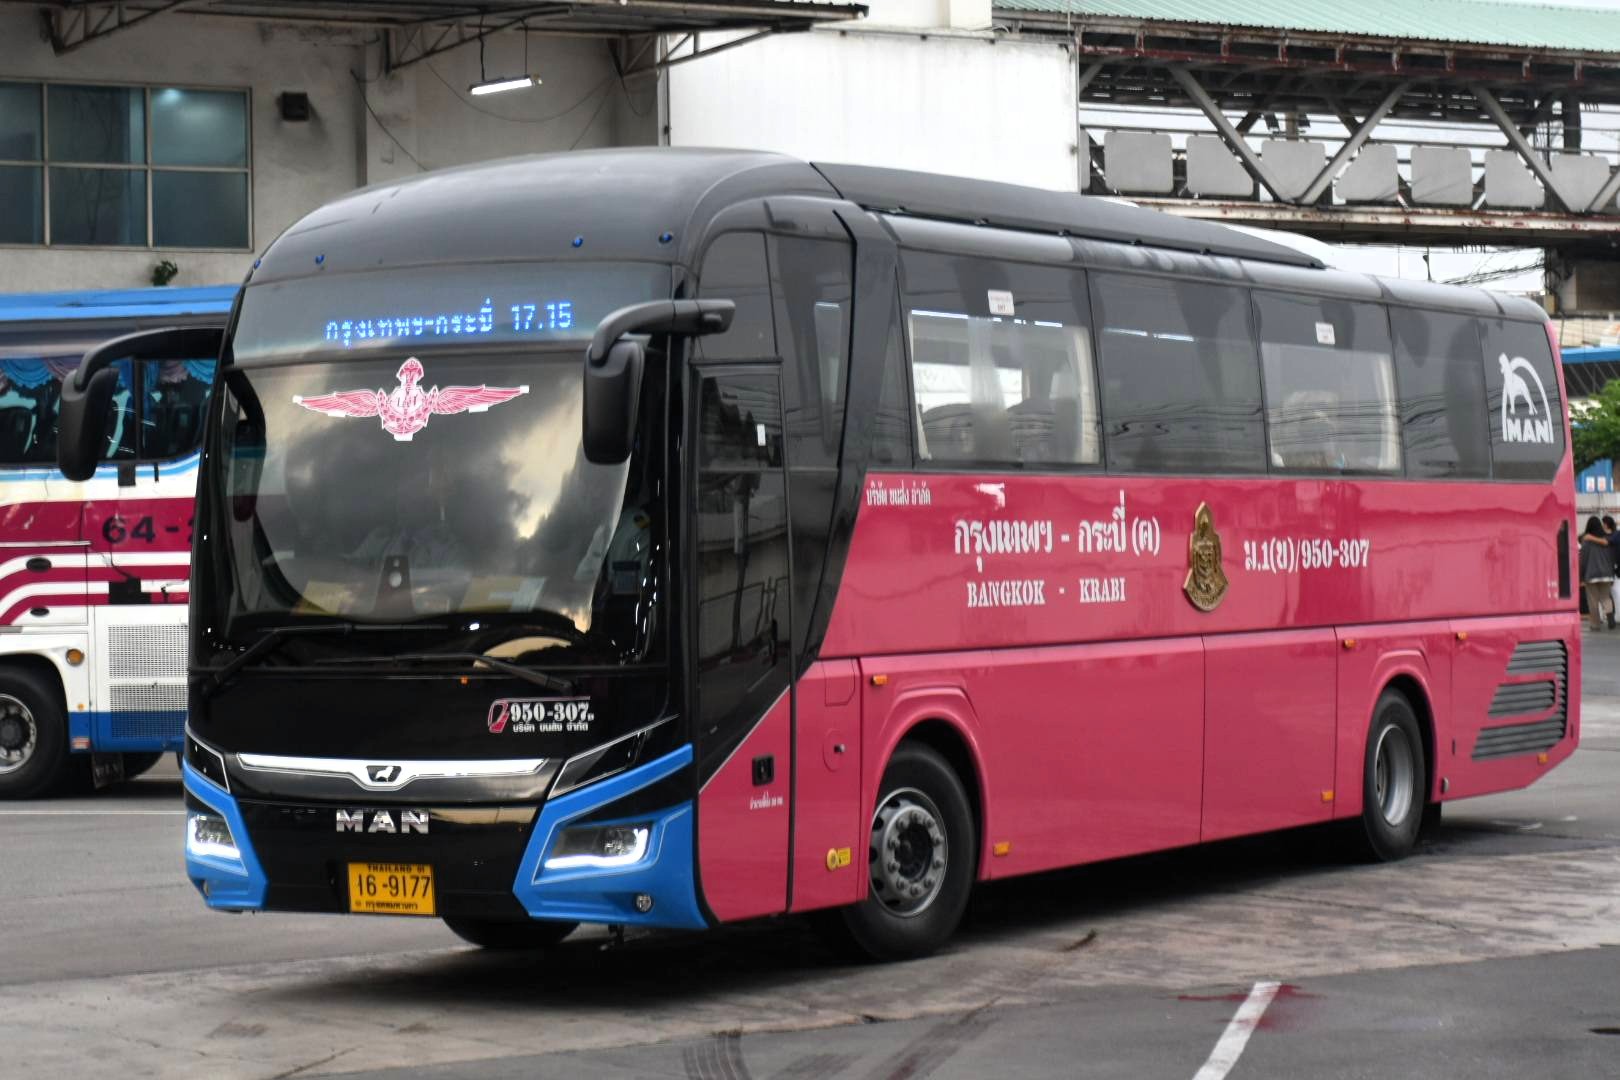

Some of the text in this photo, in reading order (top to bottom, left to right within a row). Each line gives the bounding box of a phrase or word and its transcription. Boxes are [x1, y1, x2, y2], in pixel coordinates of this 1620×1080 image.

[511, 302, 571, 331] 17.15
[1506, 418, 1549, 443] MAN
[102, 516, 194, 545] 64-
[954, 518, 1053, 573] กรุงเทพฯ
[1078, 489, 1127, 553] กระบี่
[966, 578, 1046, 608] BANGKOK
[1079, 577, 1126, 603] KRABI
[336, 808, 430, 834] MAN
[357, 874, 432, 898] 16-9177
